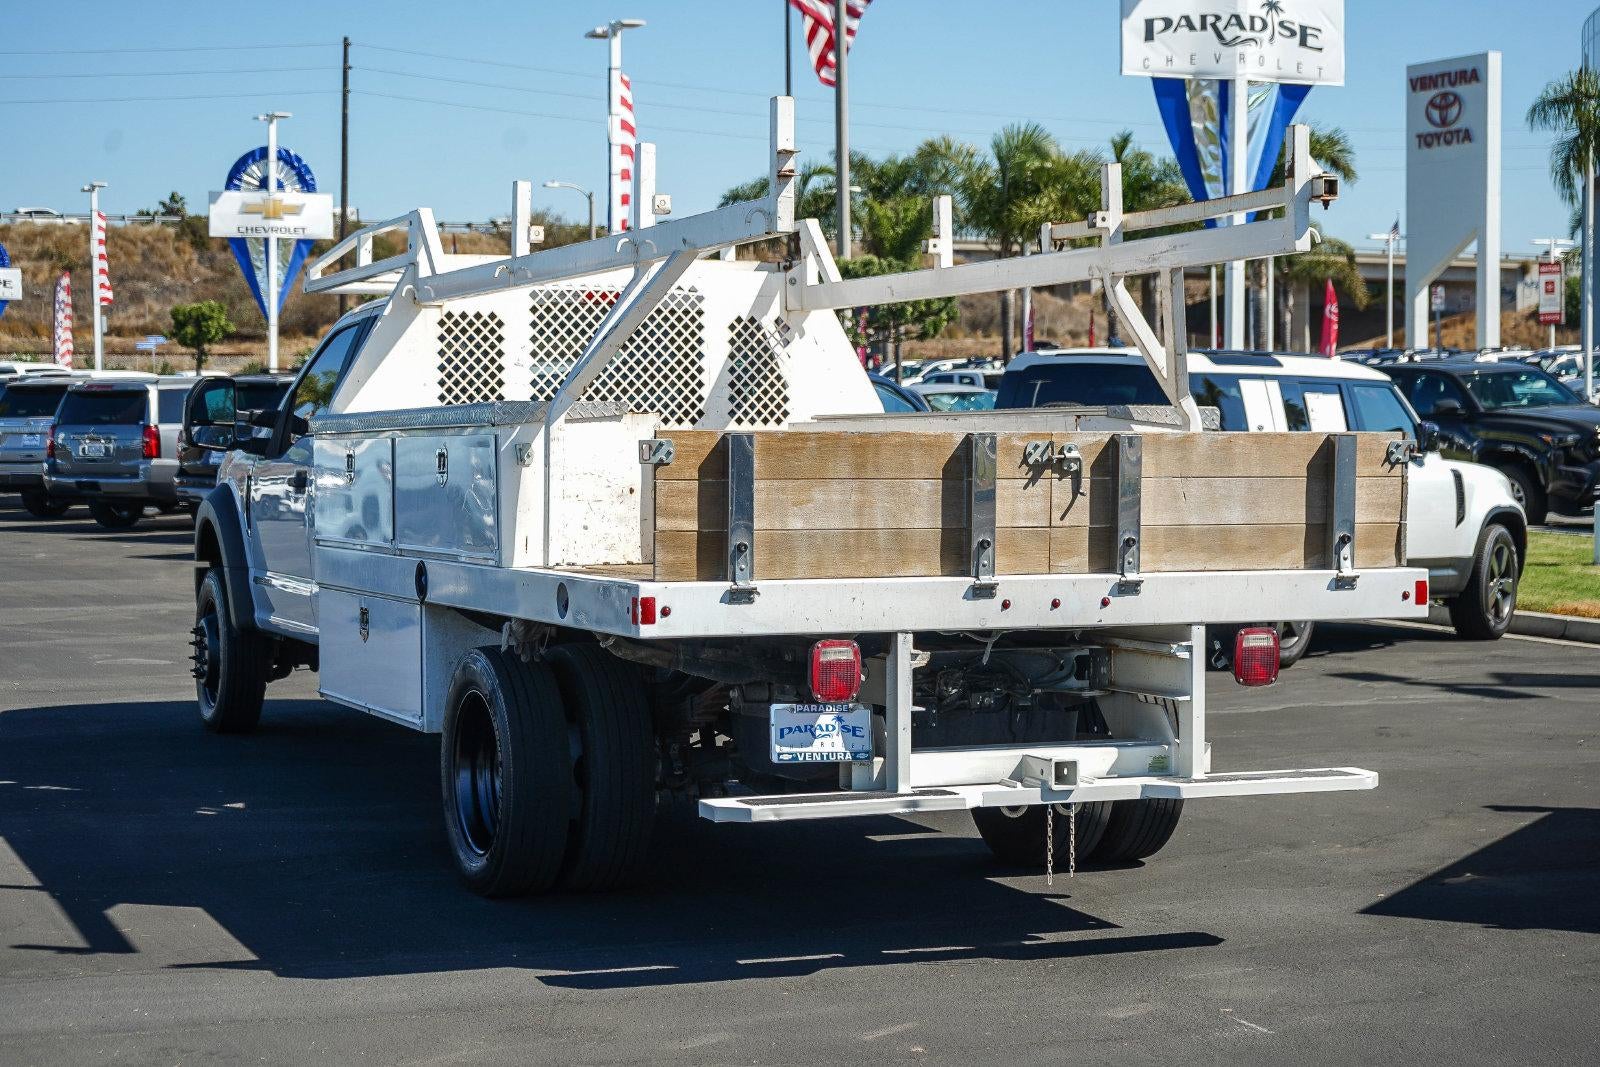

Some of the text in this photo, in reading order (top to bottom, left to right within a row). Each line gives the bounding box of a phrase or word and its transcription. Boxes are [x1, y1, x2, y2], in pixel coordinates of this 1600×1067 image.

[1144, 0, 1324, 51] PARADISE
[1143, 52, 1324, 78] CHEVROLET
[1409, 67, 1480, 93] VENTURA
[1415, 127, 1473, 149] TOYOTA
[237, 226, 307, 235] CHEVROLET
[796, 704, 849, 713] PARADISE
[779, 715, 866, 740] PARADISE
[797, 752, 852, 761] VENTURA
